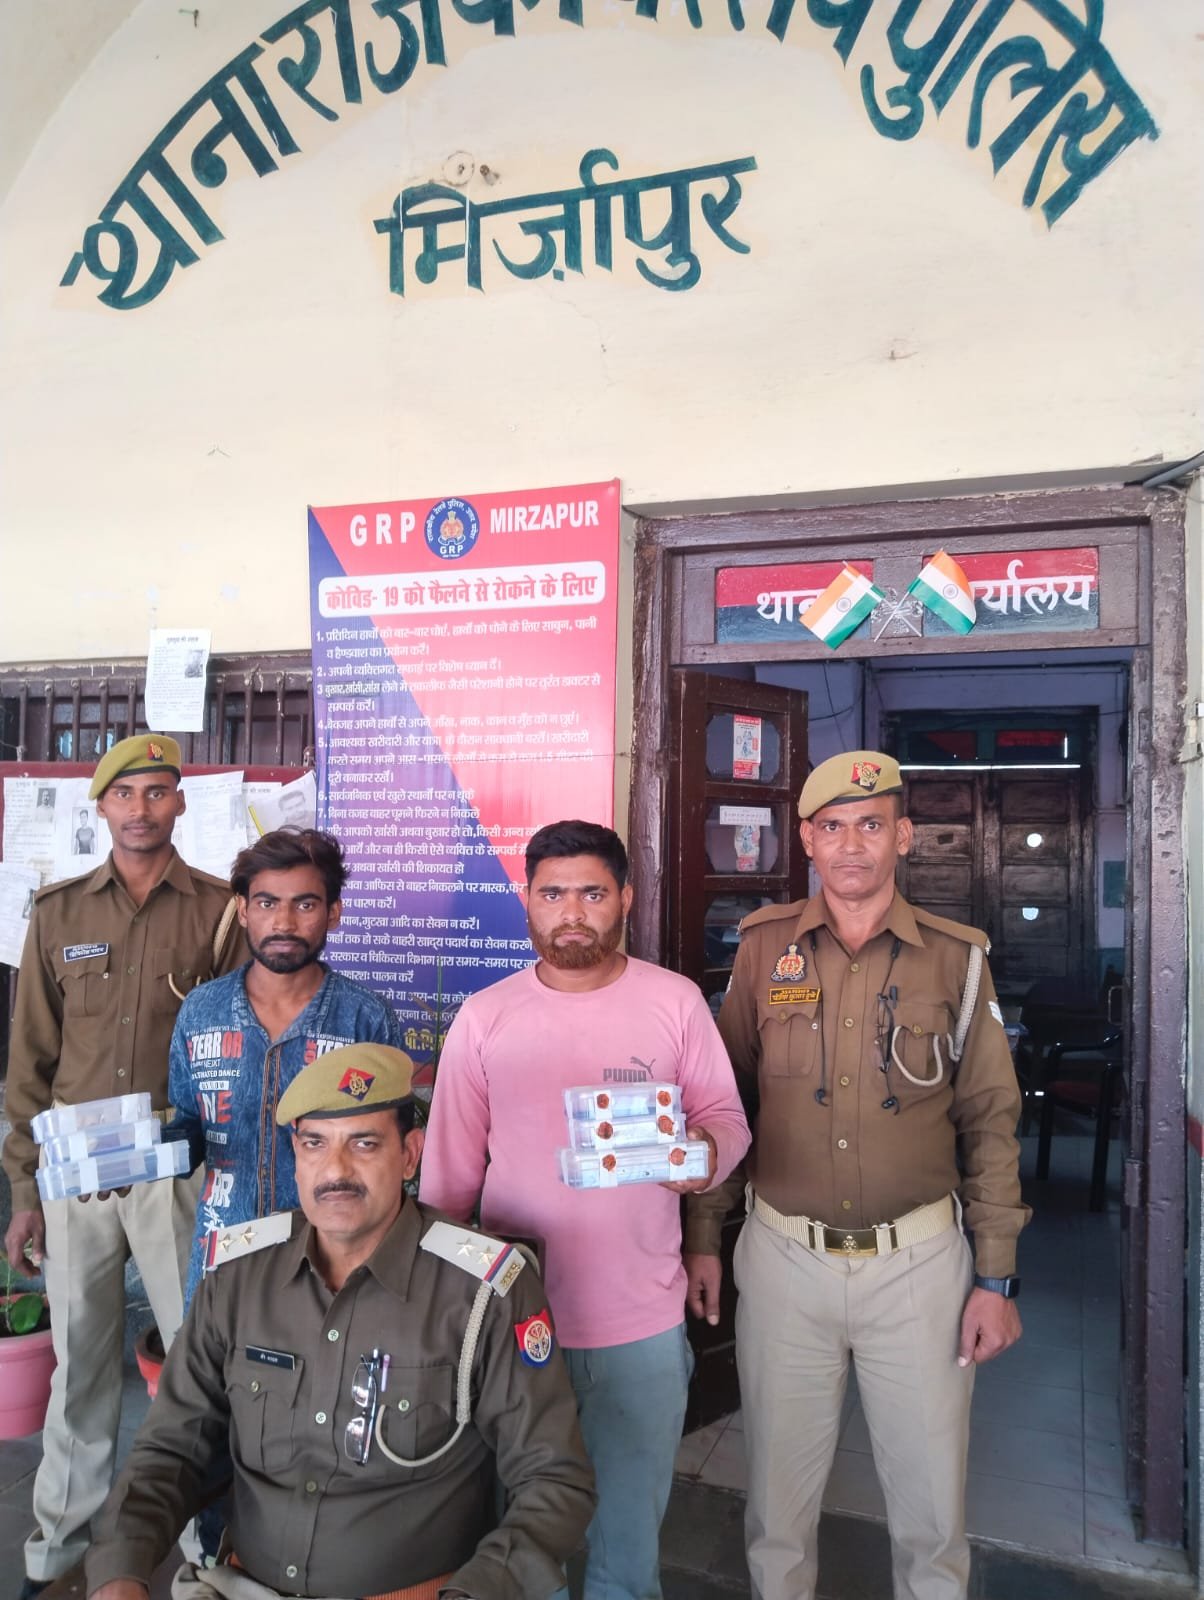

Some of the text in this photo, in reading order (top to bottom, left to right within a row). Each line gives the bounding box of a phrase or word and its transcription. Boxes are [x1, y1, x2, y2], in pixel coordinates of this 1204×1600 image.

[60, 42, 302, 310] थाना
[490, 500, 599, 534] MIRZAPUR
[384, 587, 399, 607] 19
[402, 581, 425, 606] को
[428, 579, 471, 604] फैलने
[474, 578, 489, 602] से
[492, 575, 536, 601] रोकने
[540, 573, 558, 598] के
[561, 571, 598, 597] लिए
[328, 664, 352, 677] अपनी
[317, 684, 323, 695] 3
[344, 824, 372, 837] आपको
[399, 826, 424, 837] अथवा
[450, 824, 461, 837] हो
[365, 842, 382, 855] और
[382, 843, 393, 854] ना
[394, 841, 404, 855] ही
[405, 842, 429, 855] किसी
[430, 842, 445, 856] ऐसे
[474, 843, 486, 855] के
[487, 842, 518, 856] सम्पर्क
[351, 863, 376, 873] अथवा
[402, 861, 414, 873] की
[416, 861, 453, 874] शिकायत
[454, 861, 465, 875] हो
[396, 879, 405, 891] से
[406, 881, 428, 892] बाहर
[428, 879, 464, 893] निकलने
[465, 882, 478, 893] पर
[390, 914, 411, 928] आदि
[412, 917, 424, 928] का
[426, 915, 449, 929] सेवन
[450, 918, 458, 929] न
[345, 934, 361, 944] तक
[362, 932, 372, 944] हो
[373, 932, 391, 945] सके
[392, 933, 415, 947] बाहरी
[445, 934, 469, 948] पदार्थ
[470, 939, 483, 949] का
[484, 936, 508, 949] सेवन
[509, 937, 533, 951] करने
[330, 951, 360, 962] सरकार
[407, 951, 435, 966] विभाग
[510, 959, 522, 969] पर
[371, 970, 397, 982] पालन
[396, 991, 407, 1000] या
[603, 1068, 647, 1082] PUMA
